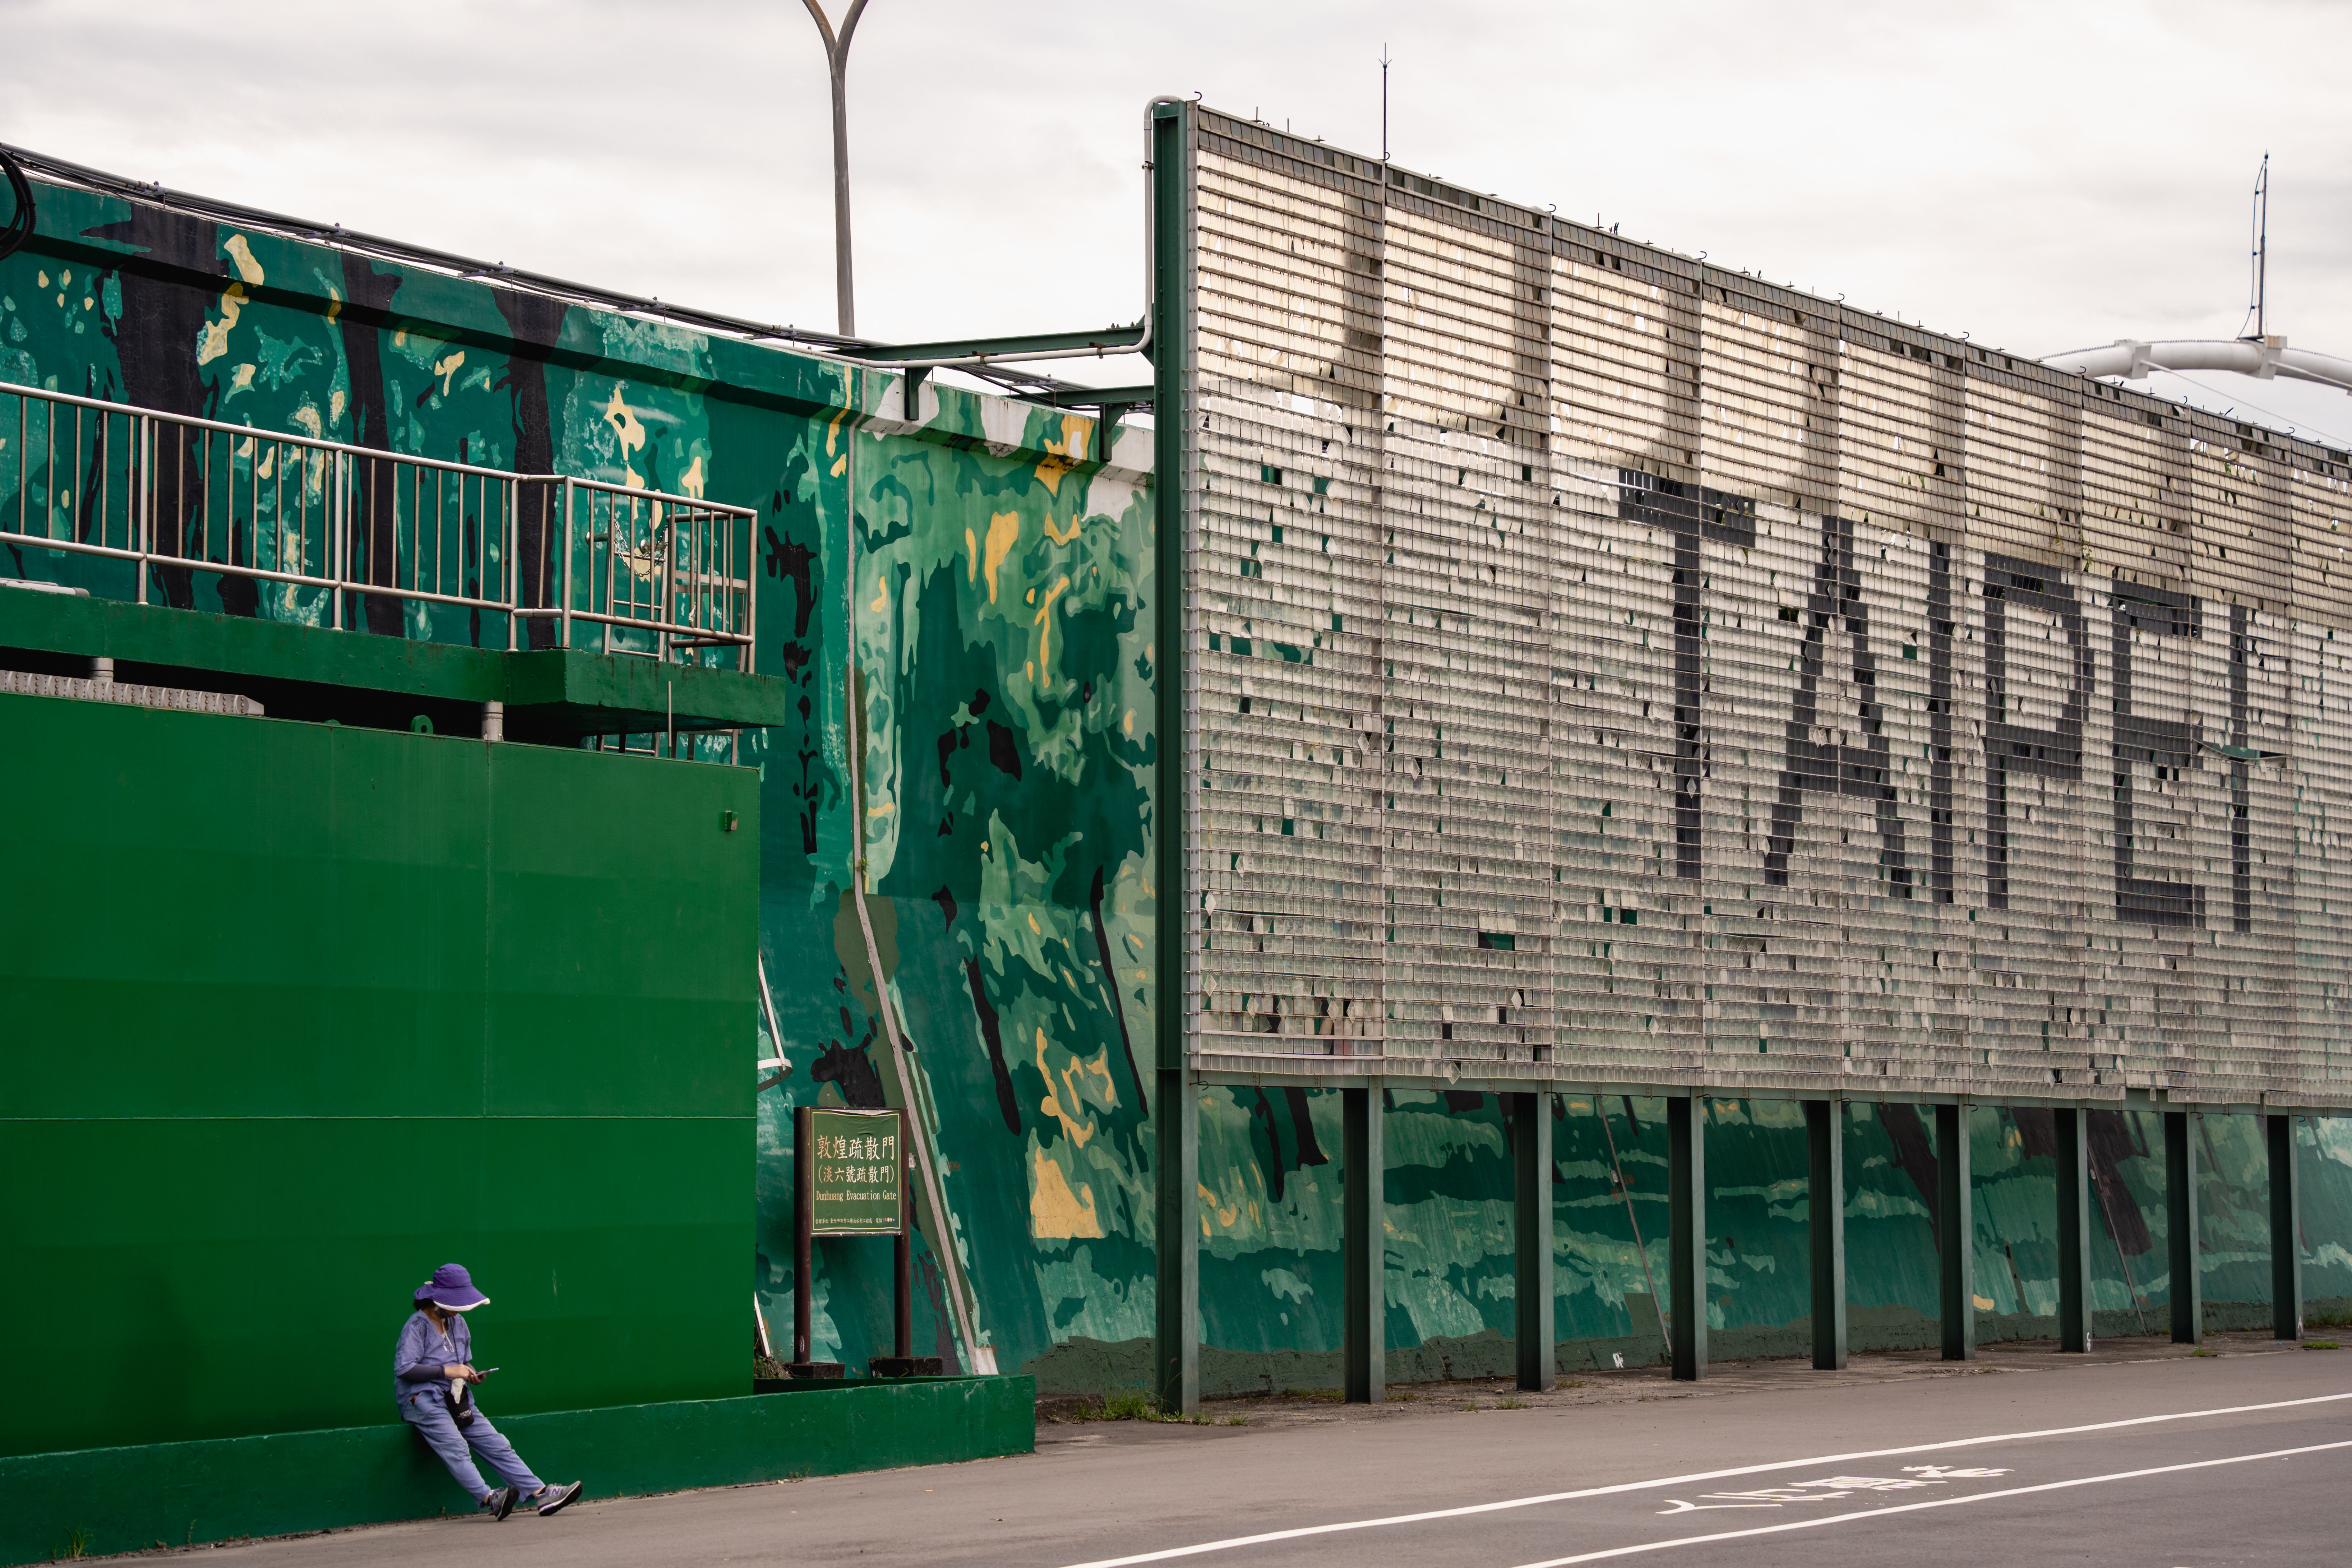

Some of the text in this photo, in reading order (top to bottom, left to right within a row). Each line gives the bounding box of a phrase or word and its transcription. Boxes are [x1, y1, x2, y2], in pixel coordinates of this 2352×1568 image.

[1618, 469, 2250, 933] TAIPEI
[817, 1135, 895, 1161] 敦煌疏散門
[818, 1165, 894, 1183] (淡六號疏散門)
[816, 1190, 897, 1202] Dunhuang Evacuation Gate
